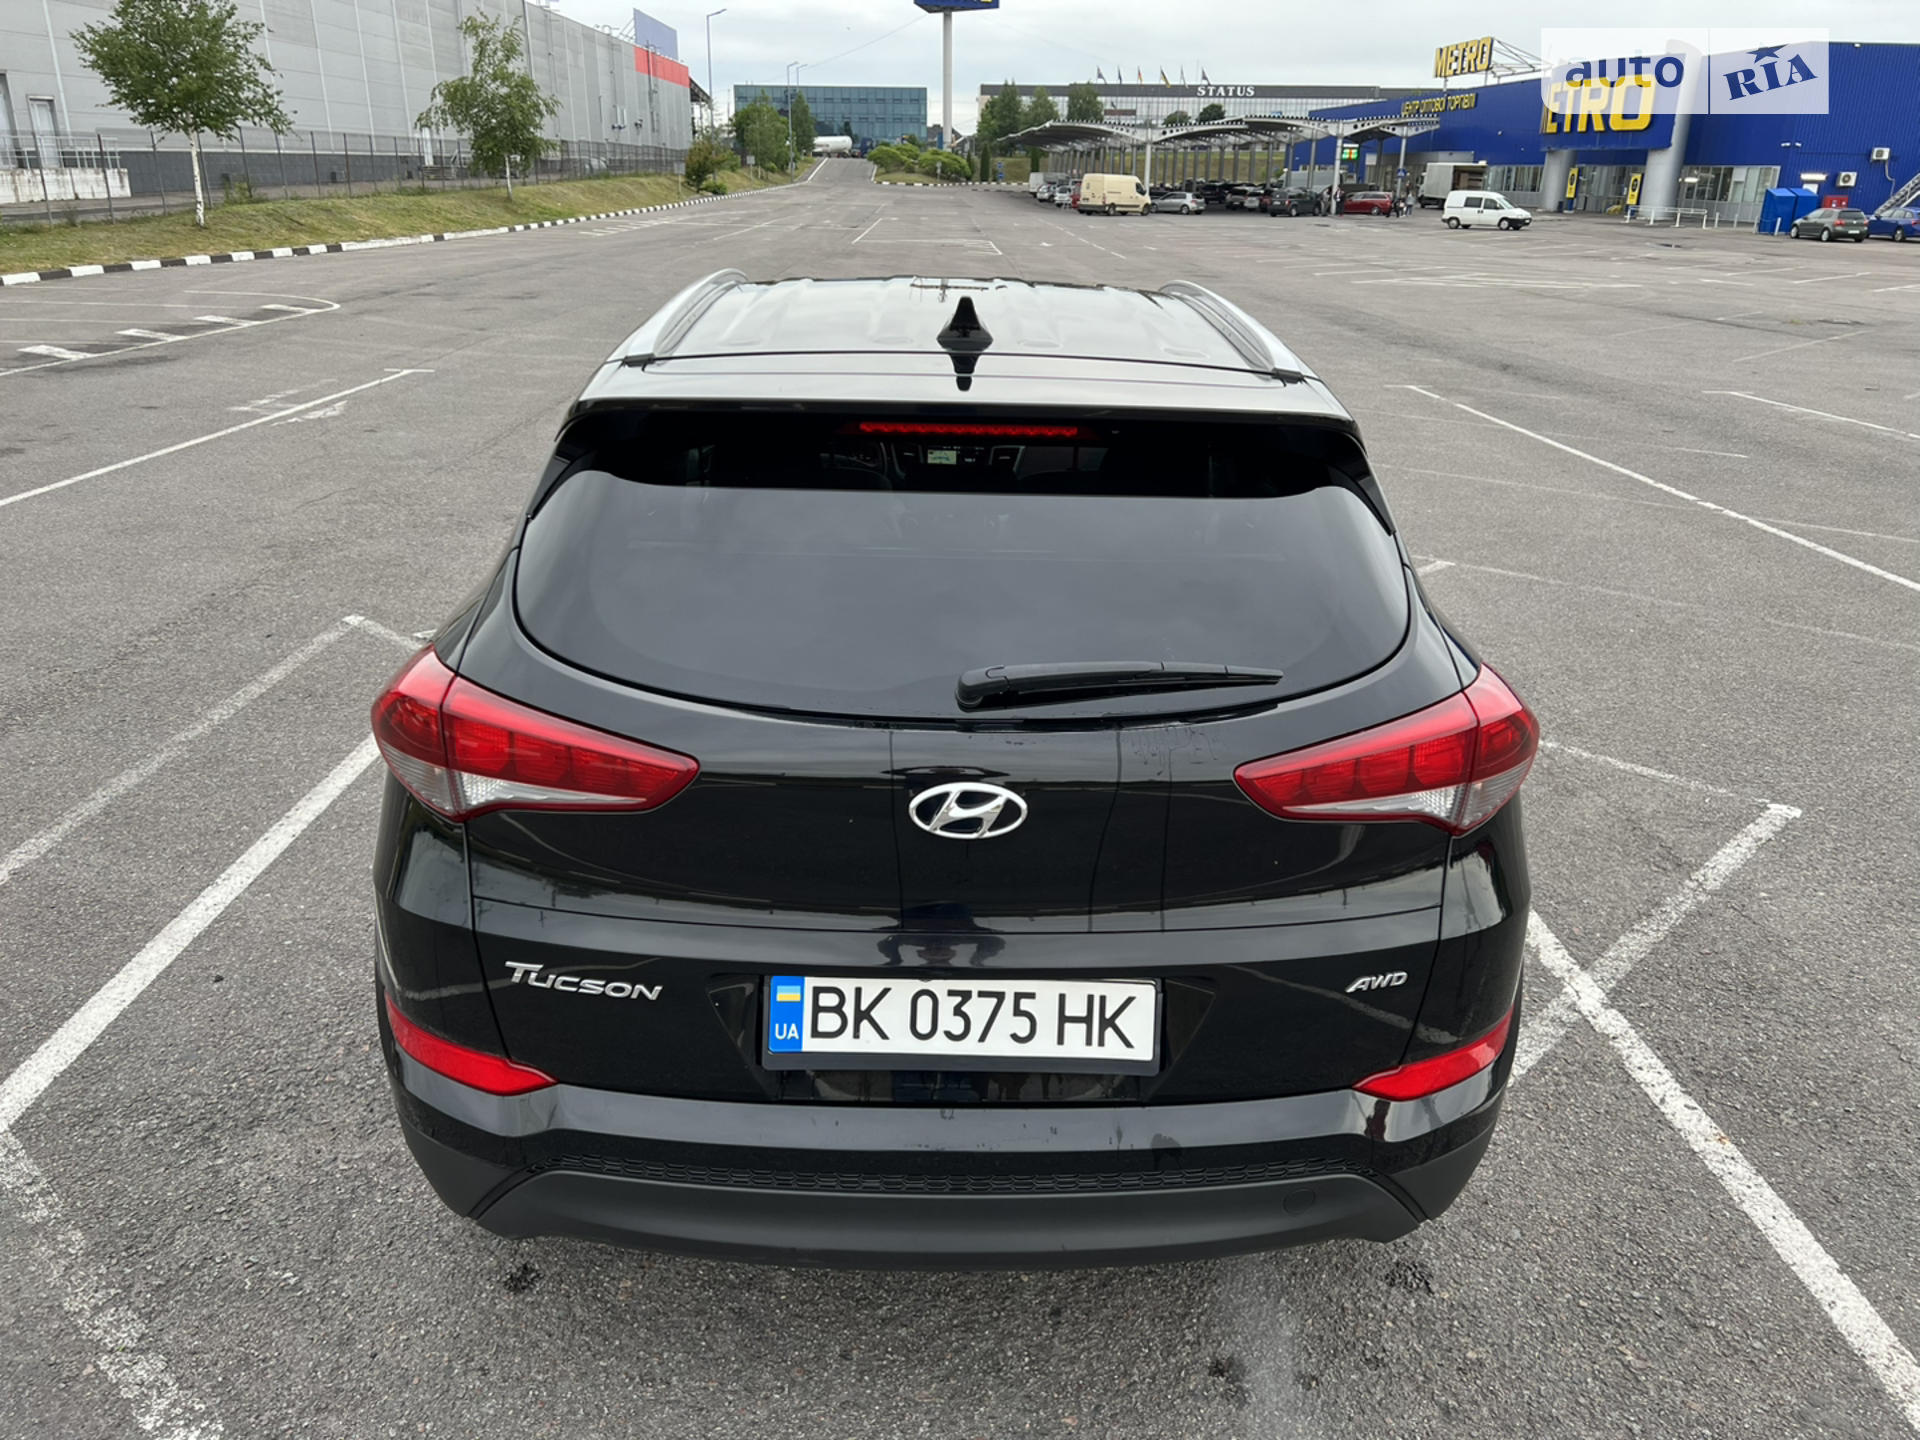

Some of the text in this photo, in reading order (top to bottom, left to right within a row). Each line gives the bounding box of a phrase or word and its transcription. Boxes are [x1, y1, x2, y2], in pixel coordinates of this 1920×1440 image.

[1435, 36, 1493, 78] METRO
[1197, 86, 1255, 97] STATUS
[504, 961, 663, 1001] TUCSON
[1345, 970, 1408, 993] AWD
[775, 1023, 800, 1041] UA
[810, 985, 1137, 1049] BK 0375 HK
